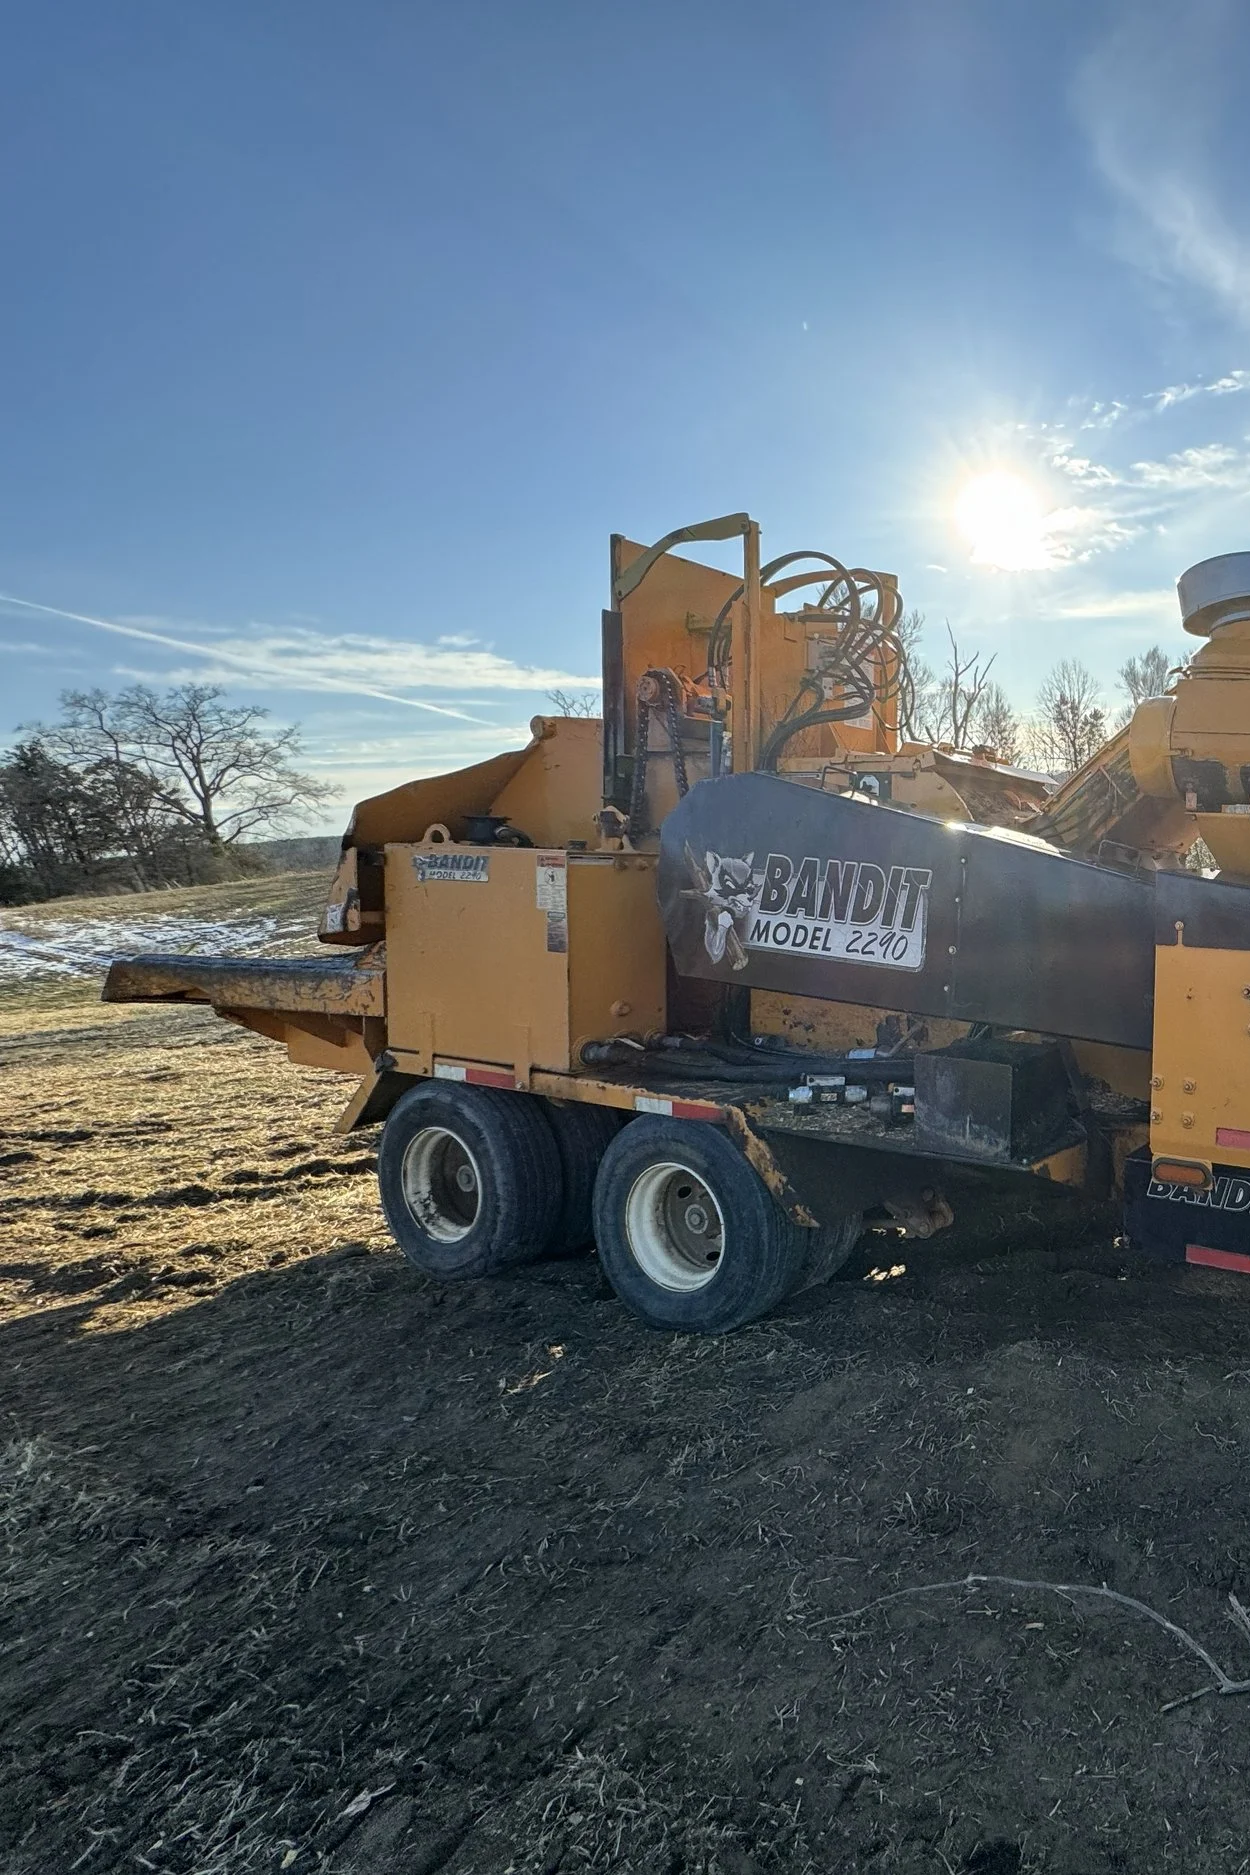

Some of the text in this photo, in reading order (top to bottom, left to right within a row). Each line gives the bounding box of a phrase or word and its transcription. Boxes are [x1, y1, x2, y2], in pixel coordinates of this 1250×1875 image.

[758, 853, 933, 932] BANDIT
[750, 919, 908, 961] MODEL 2290
